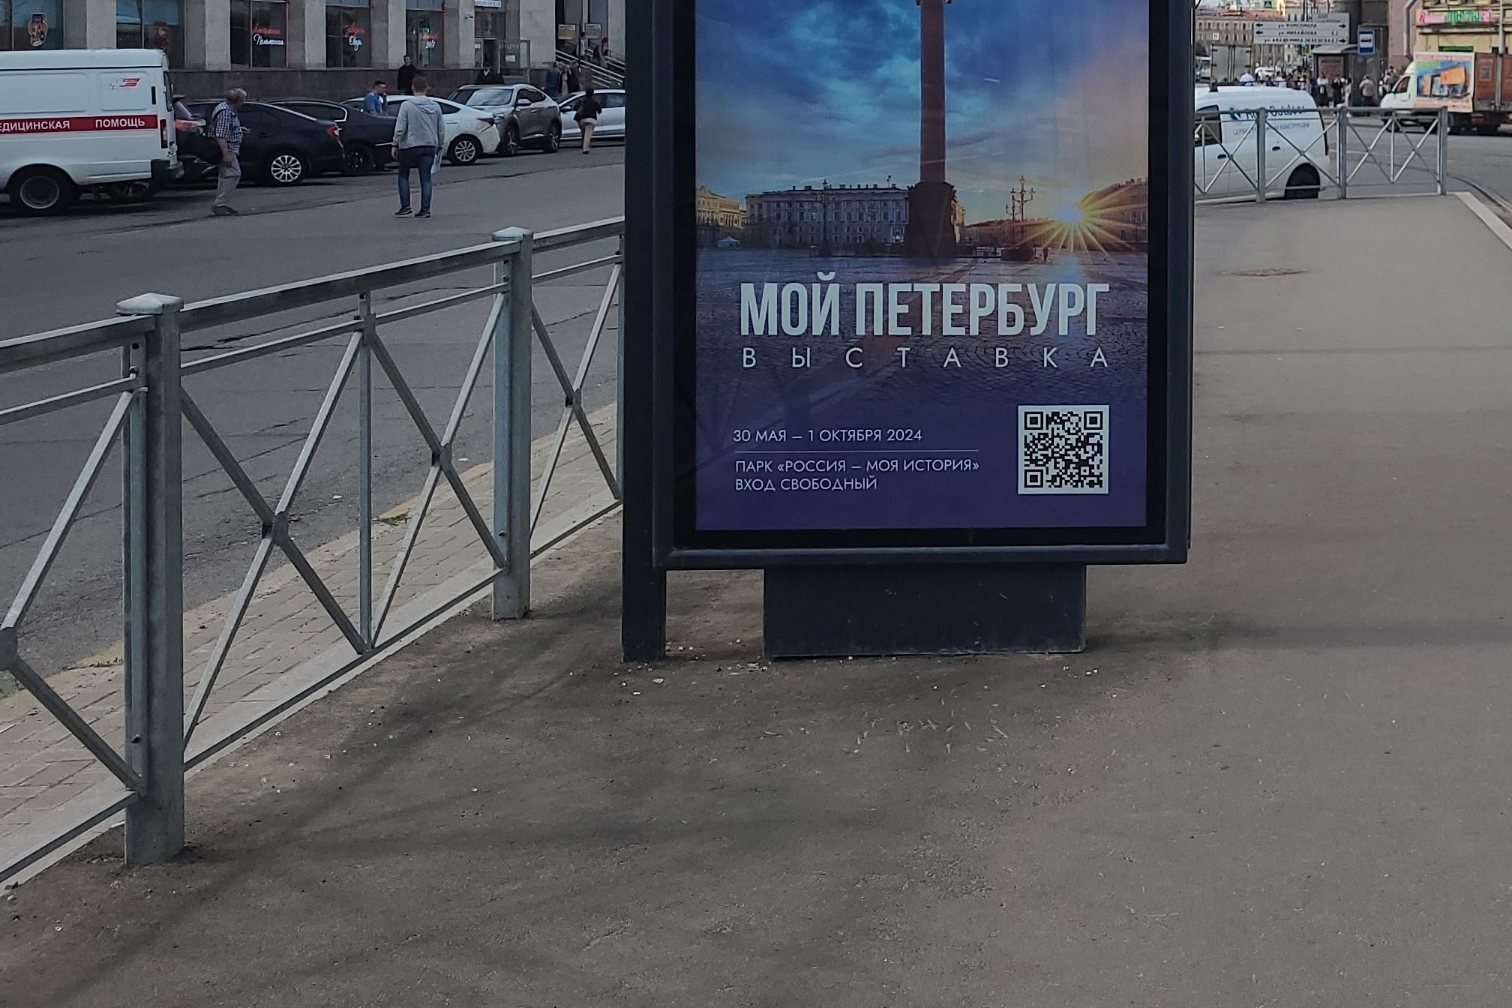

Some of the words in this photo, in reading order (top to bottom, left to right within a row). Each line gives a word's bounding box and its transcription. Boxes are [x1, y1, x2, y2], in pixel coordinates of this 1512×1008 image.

[95, 118, 146, 128] ПОМОЩЬ
[740, 271, 840, 336] МОЙ
[855, 283, 1110, 336] ПЕТЕРБУРГ
[742, 347, 1109, 368] ВЫСТАВКА
[733, 430, 751, 442] 30
[755, 430, 787, 442] МАЯ
[808, 430, 814, 441] 1
[819, 429, 882, 442] ОКТЯБРЯ
[887, 429, 922, 441] 2024
[735, 461, 773, 473] ПАРК
[777, 460, 846, 472] «РОССИЯ
[866, 460, 899, 471] МОЯ
[904, 459, 980, 471] ИСТОРИЯ»
[735, 479, 776, 492] ВХОД
[780, 475, 877, 491] СВОБОДНЫЙ
